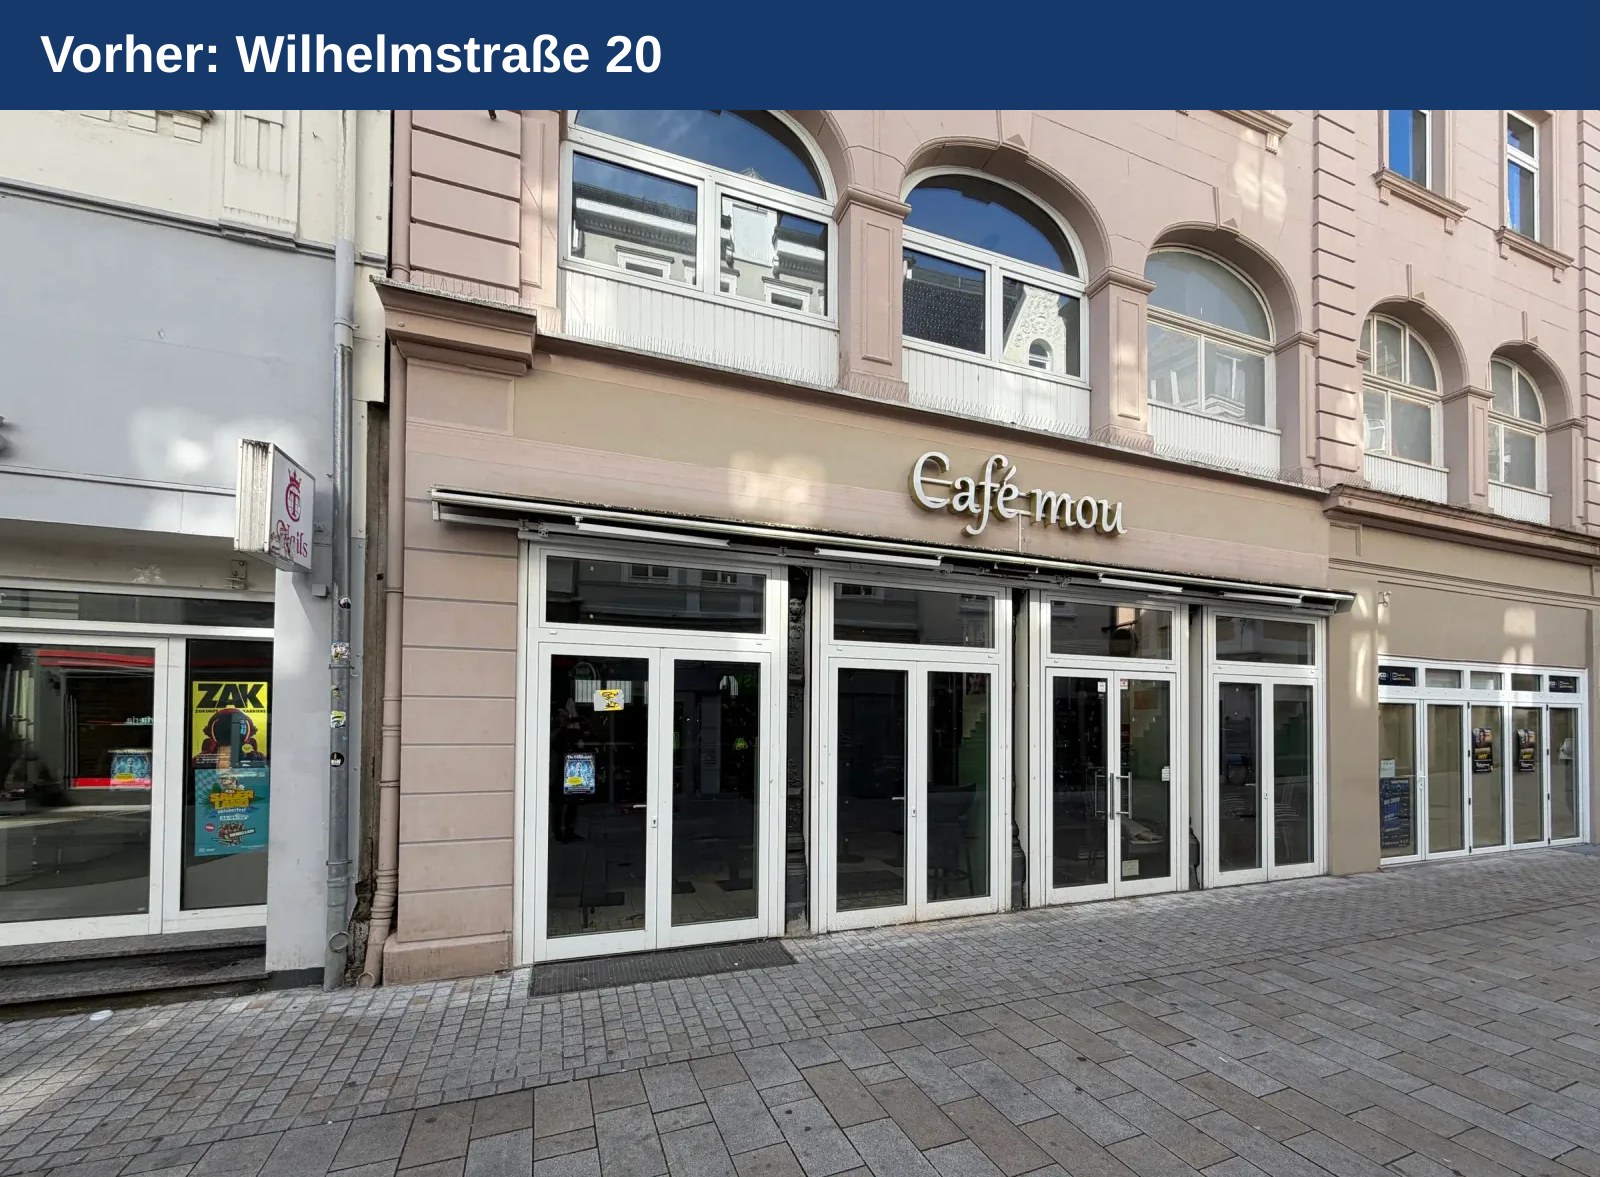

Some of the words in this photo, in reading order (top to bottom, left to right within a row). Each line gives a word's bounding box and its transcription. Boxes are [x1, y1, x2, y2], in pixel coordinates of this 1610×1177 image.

[908, 451, 1020, 537] Café
[1029, 489, 1127, 536] mou
[195, 683, 265, 709] ZAK
